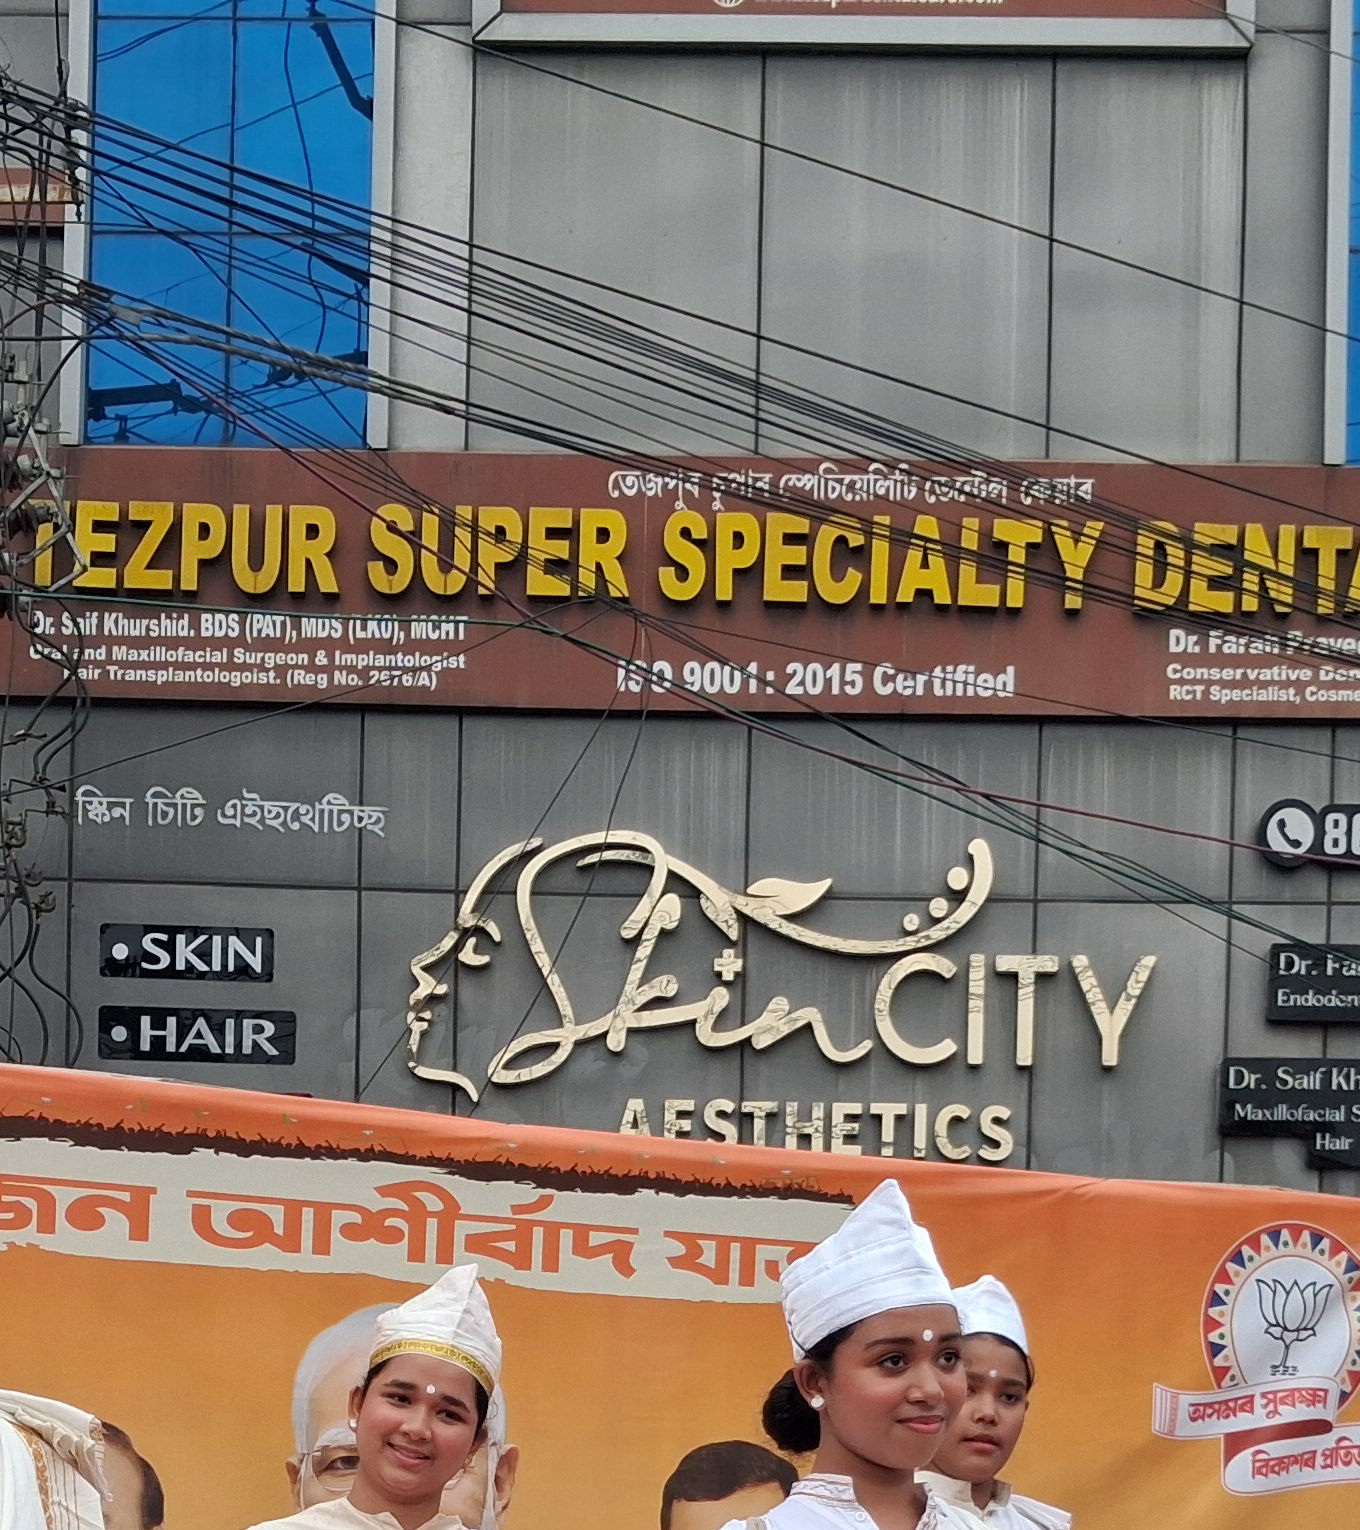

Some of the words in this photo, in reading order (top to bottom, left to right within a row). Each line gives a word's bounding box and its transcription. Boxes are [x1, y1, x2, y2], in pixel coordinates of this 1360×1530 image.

[28, 499, 340, 594] TEZPUR
[367, 502, 630, 599] SUPER
[658, 508, 1104, 609] SPECIALTY
[103, 612, 195, 638] Khurshid.
[200, 613, 241, 638] BDS
[245, 613, 297, 644] (PAT),
[301, 615, 343, 639] MDS
[1168, 628, 1201, 654] Dr.
[112, 645, 228, 663] Maxillofacial
[233, 648, 309, 669] Surgeon
[315, 650, 328, 666] &
[334, 650, 466, 671] Implantologist
[1166, 663, 1313, 681] Conservative
[286, 669, 328, 689] (Reg
[333, 670, 364, 686] No.
[784, 662, 864, 695] 2015
[873, 662, 1016, 698] Certified
[1169, 684, 1205, 700] RCT
[1209, 684, 1301, 704] Specialist,
[141, 932, 264, 974] SKIN
[1278, 953, 1317, 976] Dr.
[873, 953, 1158, 1070] CITY
[140, 1015, 280, 1057] HAIR
[1228, 1066, 1268, 1090] Dr.
[1275, 1066, 1327, 1090] Saif
[1234, 1103, 1345, 1122] Maxillofacial
[620, 1098, 1014, 1162] AESTHETICS
[1315, 1132, 1354, 1150] Hair
[1188, 1394, 1255, 1422] অসমৰ
[1259, 1388, 1330, 1420] সুৰক্ষা
[1250, 1449, 1316, 1480] বিকাশৰ
